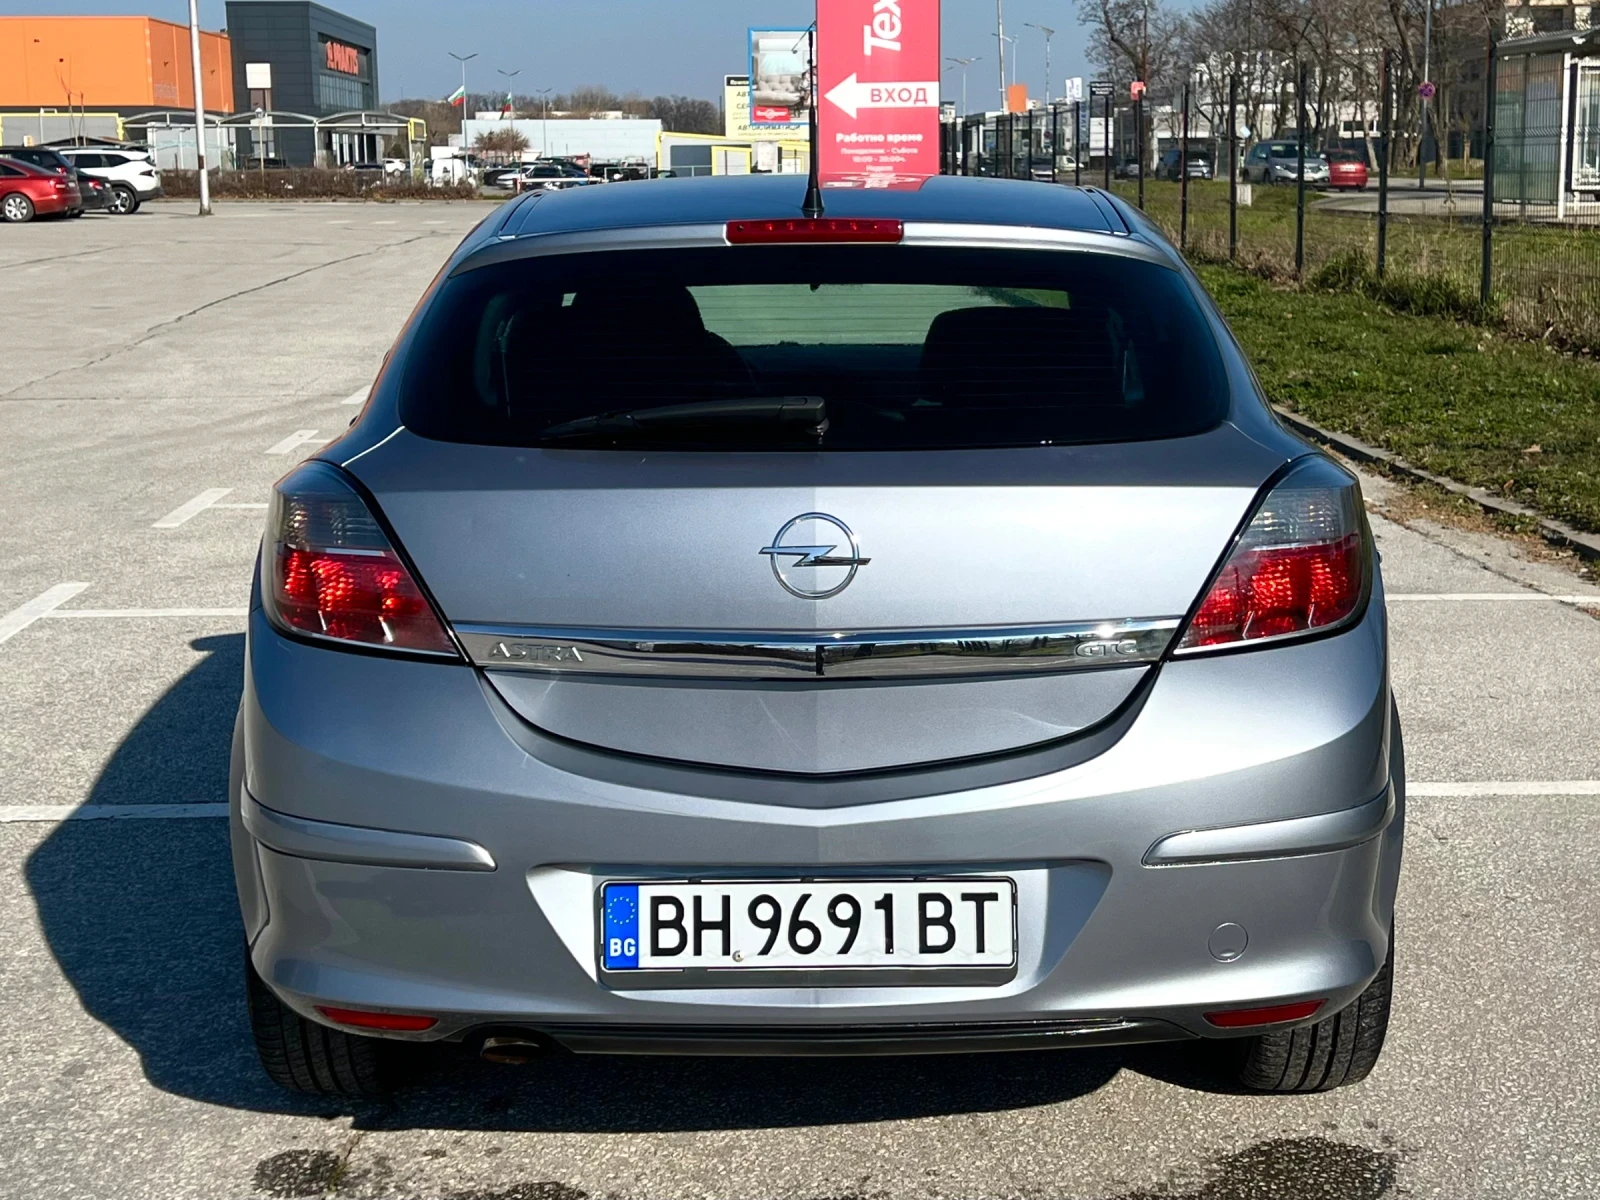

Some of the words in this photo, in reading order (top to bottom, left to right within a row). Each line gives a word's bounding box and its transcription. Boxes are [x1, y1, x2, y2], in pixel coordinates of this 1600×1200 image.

[871, 88, 928, 104] ВХОД
[836, 133, 885, 142] Работно
[886, 134, 923, 143] време
[489, 642, 583, 661] ASTRA
[1076, 639, 1137, 657] GTC
[650, 895, 731, 956] BH
[747, 893, 894, 955] 9691
[918, 893, 999, 954] BT
[609, 938, 636, 957] BG
